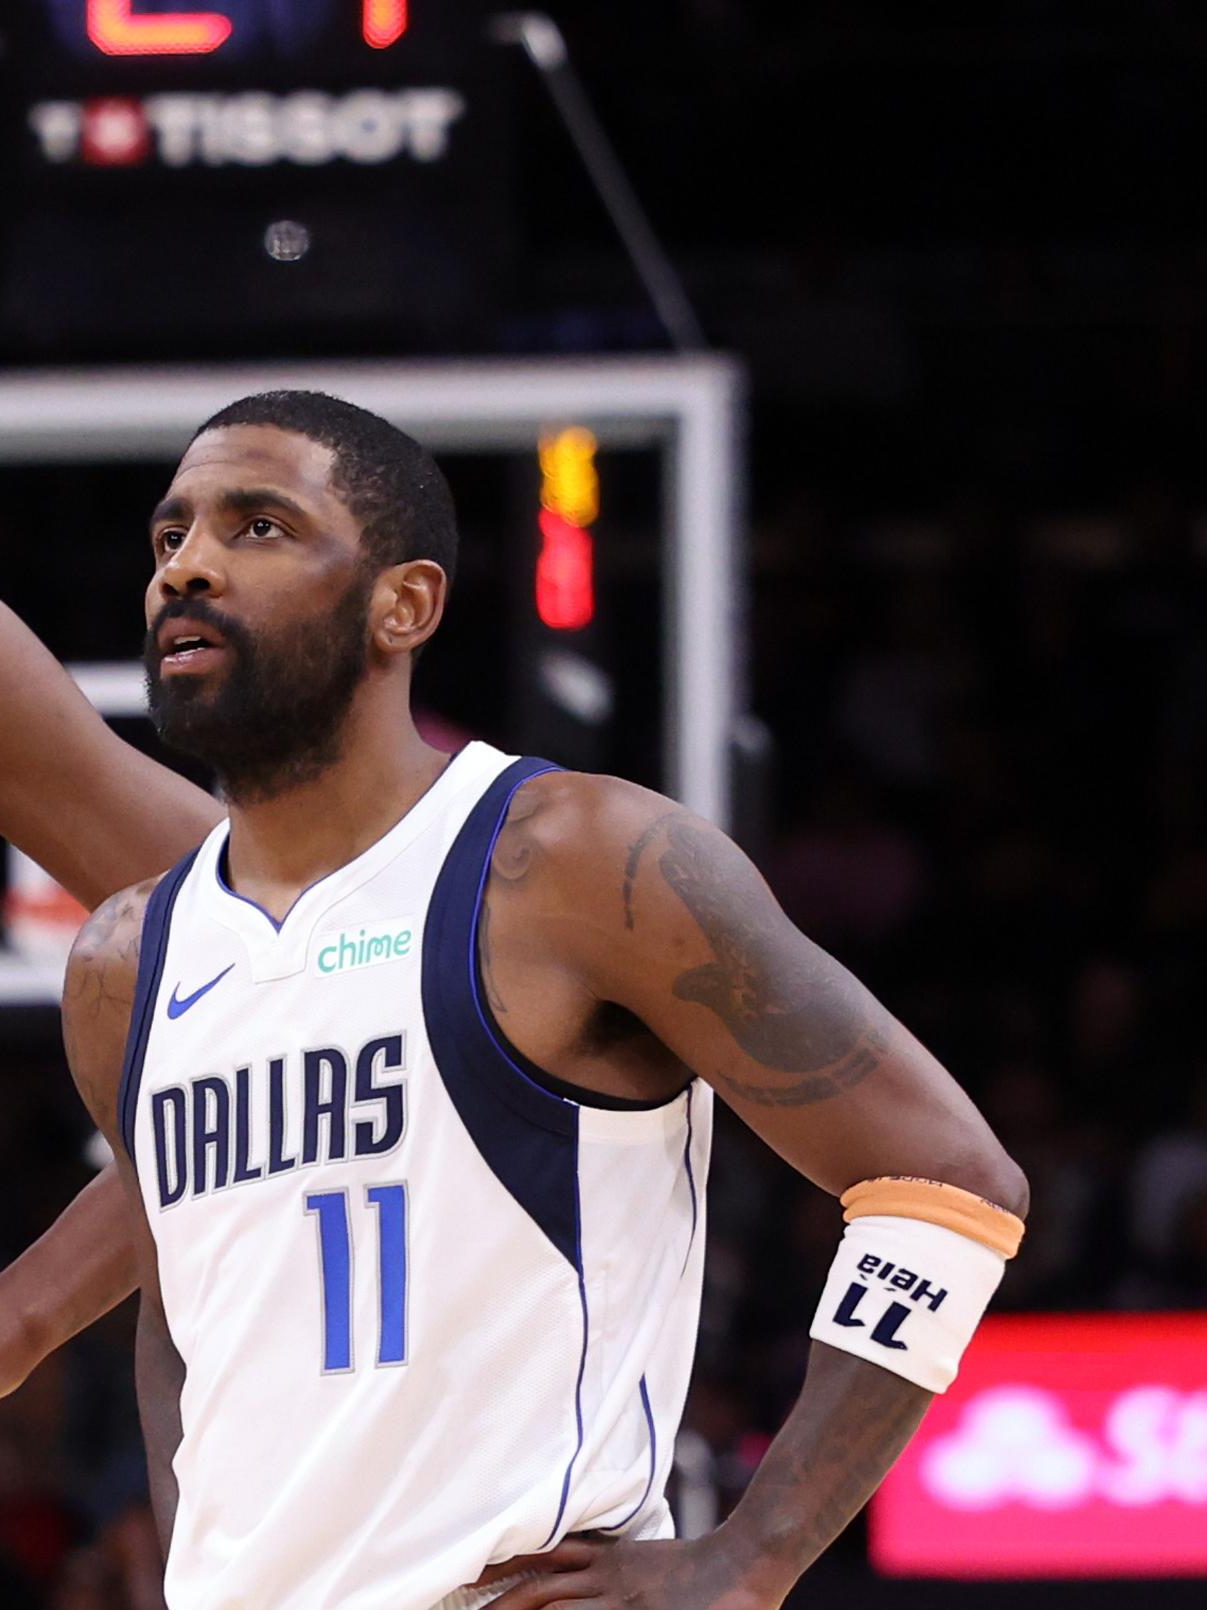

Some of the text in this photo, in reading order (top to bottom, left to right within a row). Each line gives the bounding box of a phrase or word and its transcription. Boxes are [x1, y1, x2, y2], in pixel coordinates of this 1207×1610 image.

[145, 88, 463, 166] TISSOT
[317, 929, 412, 973] chime
[150, 1030, 408, 1213] DALLAS
[303, 1179, 409, 1375] 11
[832, 1281, 912, 1351] 11
